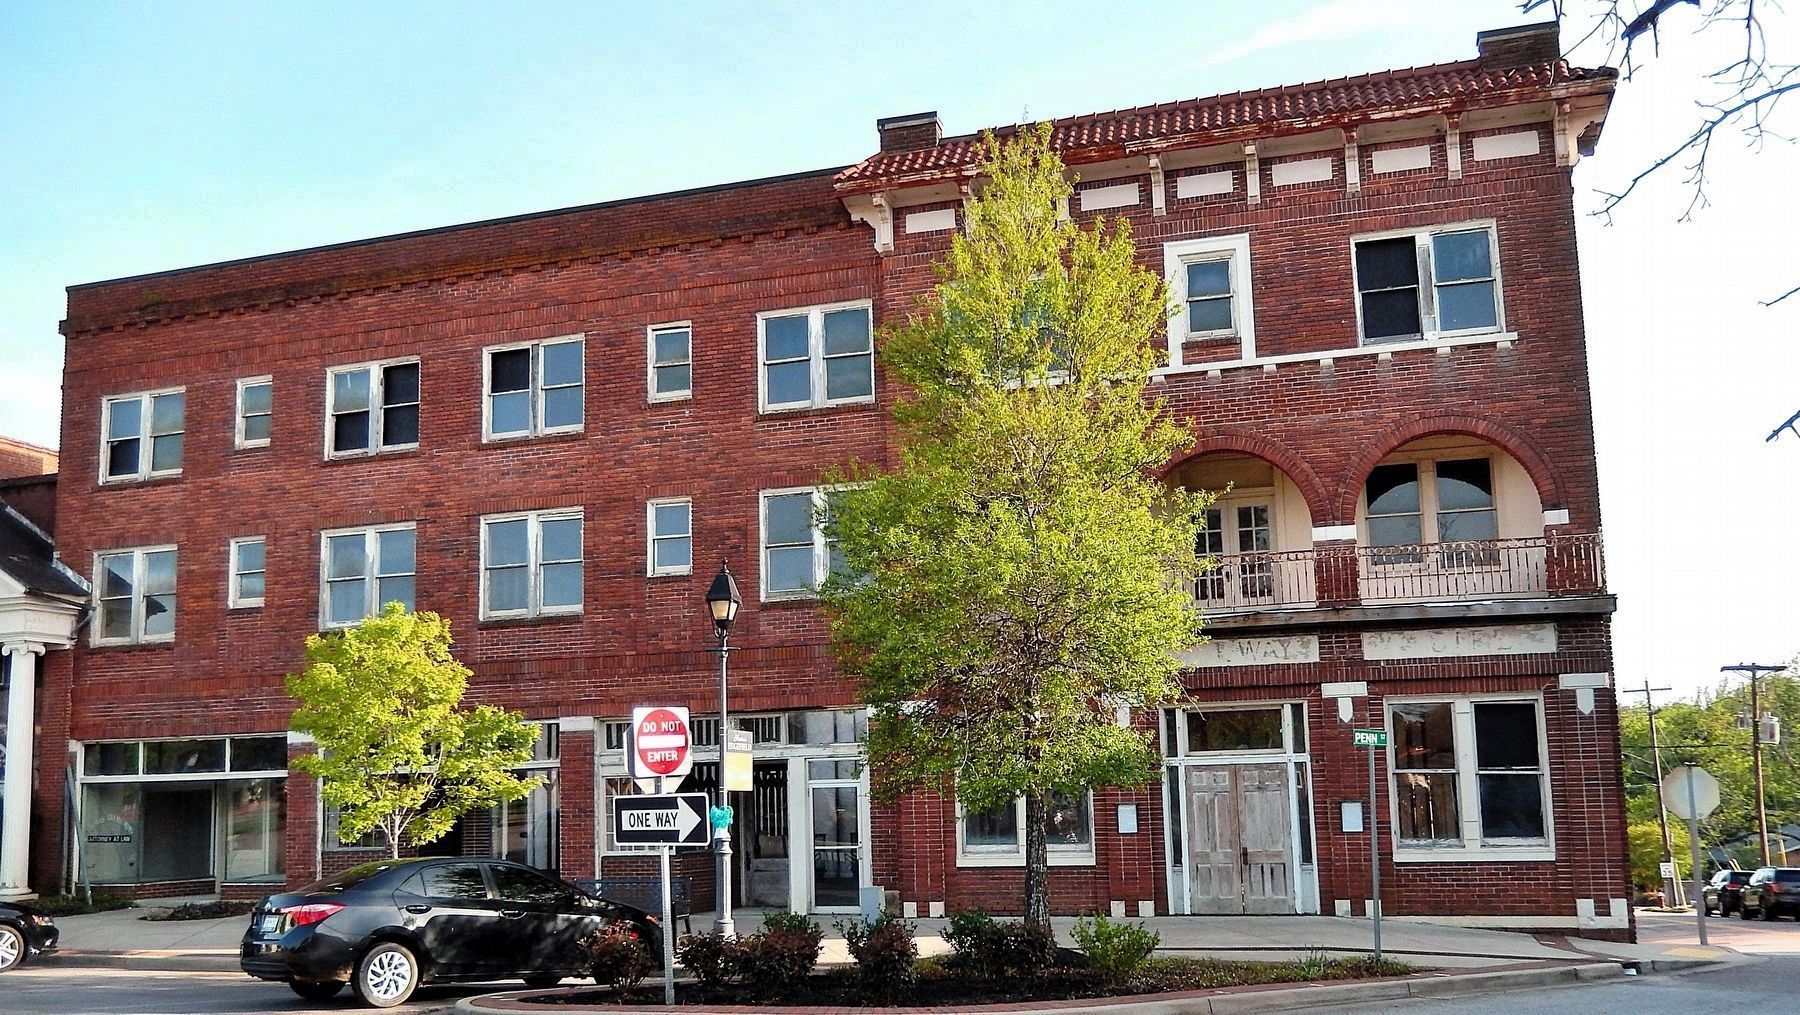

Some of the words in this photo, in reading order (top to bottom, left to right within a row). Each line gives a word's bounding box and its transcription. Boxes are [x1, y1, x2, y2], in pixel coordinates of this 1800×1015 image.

[643, 721, 657, 733] DO
[661, 720, 681, 732] NOT
[1354, 732, 1378, 744] PENN
[647, 750, 679, 763] ENTER
[628, 812, 651, 828] ONE
[655, 811, 679, 828] WAY
